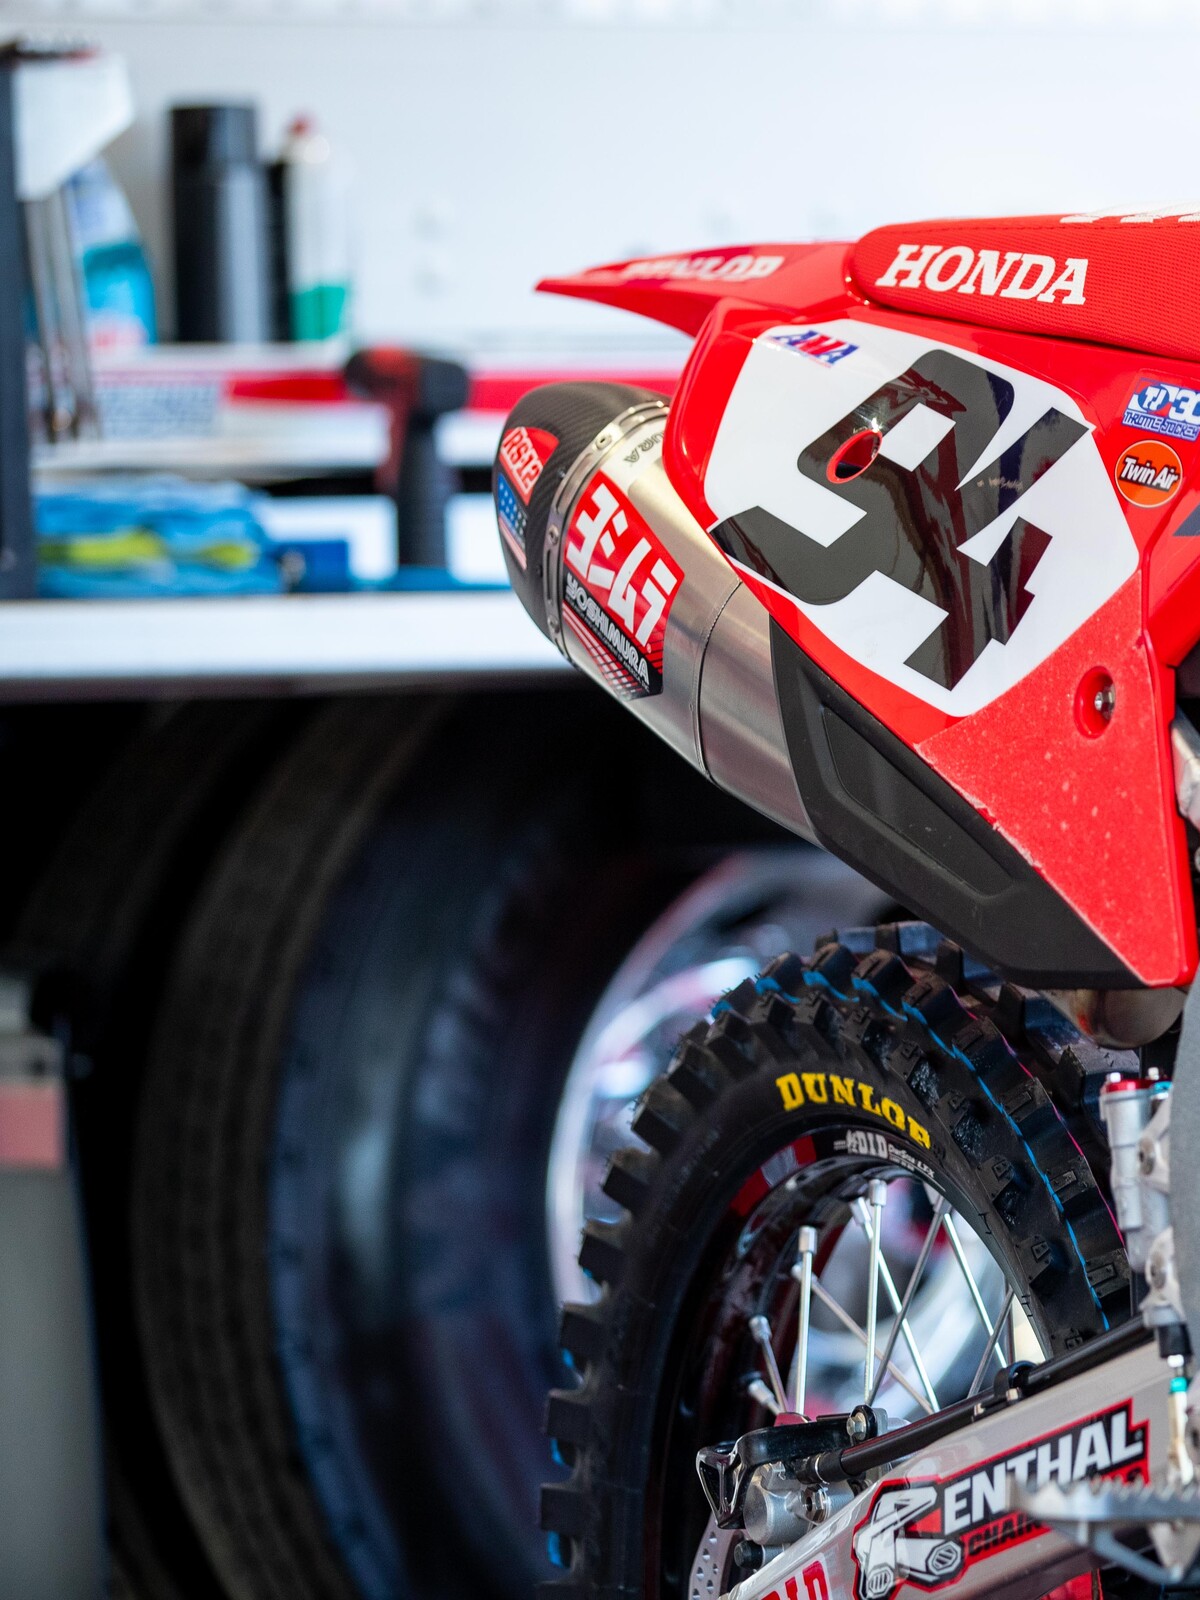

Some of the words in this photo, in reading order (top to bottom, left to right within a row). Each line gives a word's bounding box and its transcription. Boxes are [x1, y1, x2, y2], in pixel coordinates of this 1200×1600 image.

[876, 244, 1088, 305] HONDA
[1120, 457, 1156, 485] Twin
[1152, 466, 1179, 490] Air
[709, 348, 1092, 692] 94
[565, 572, 651, 688] YOSHIMURA
[775, 1072, 932, 1149] DUNLOP
